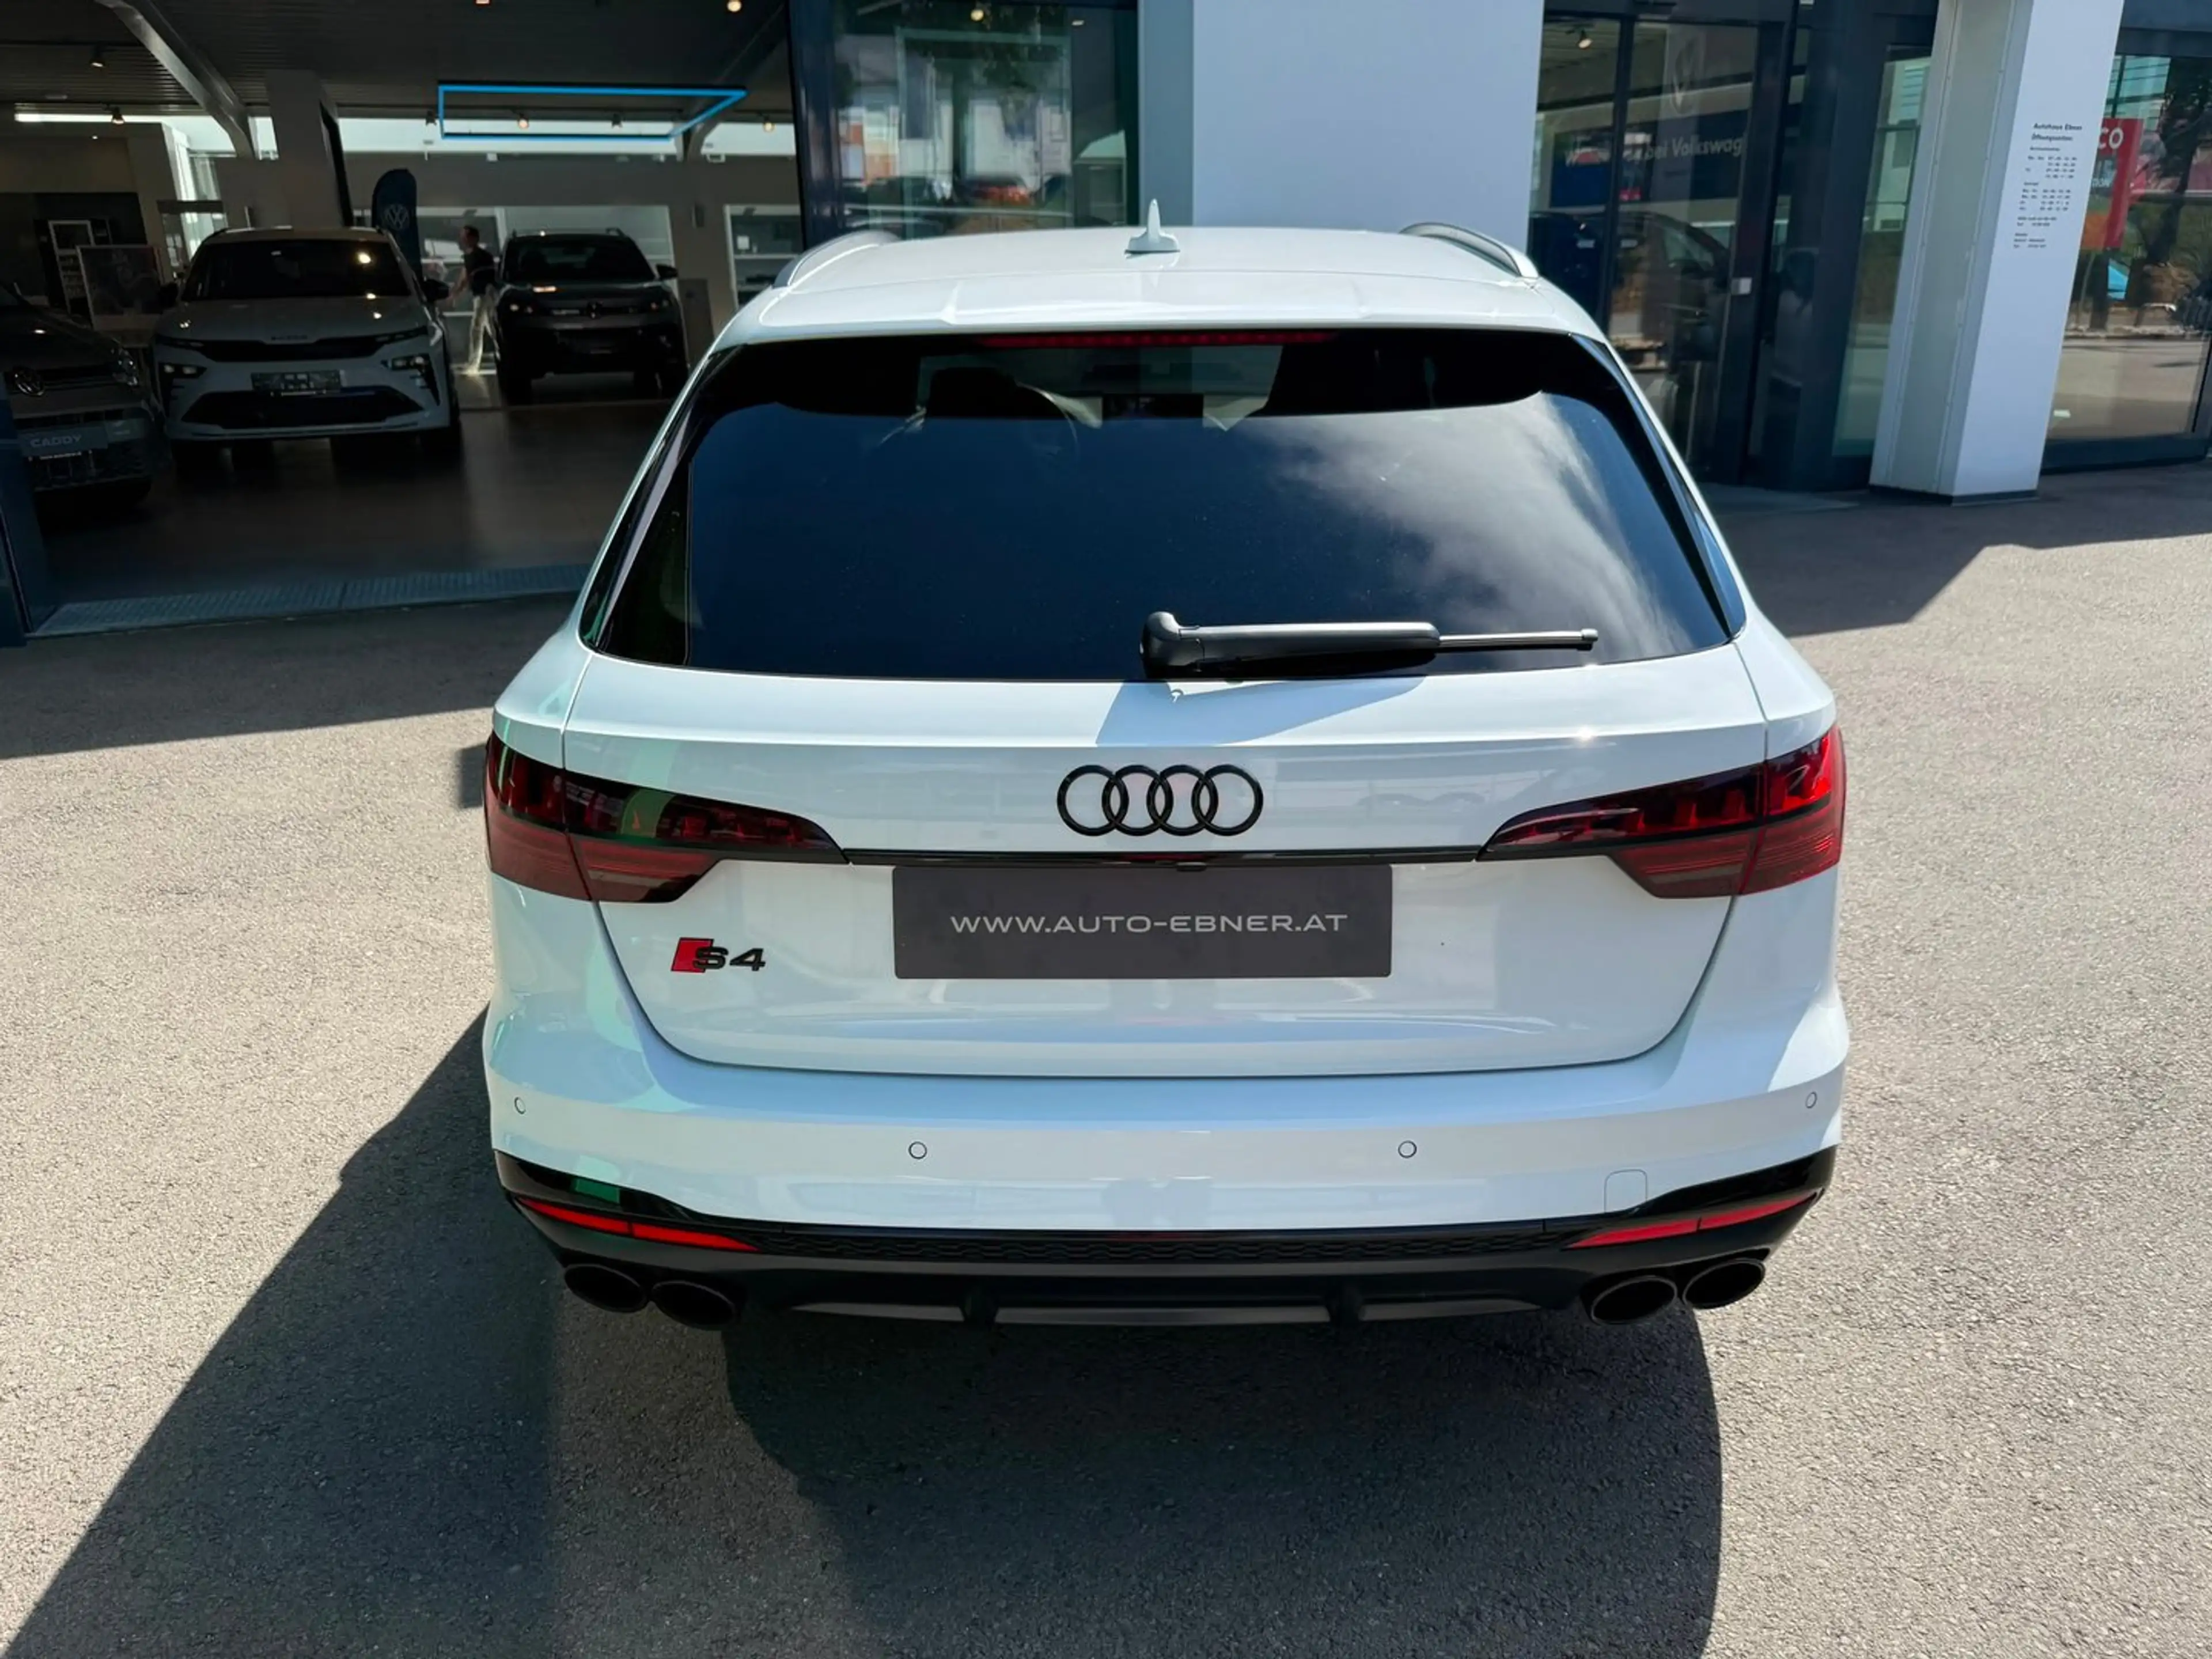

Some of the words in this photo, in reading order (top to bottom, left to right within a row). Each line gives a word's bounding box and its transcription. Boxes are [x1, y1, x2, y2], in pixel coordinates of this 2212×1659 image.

[30, 434, 82, 448] CADDY
[950, 914, 1349, 933] WWW.AUTO-EBNER.AT
[693, 946, 766, 972] S4
